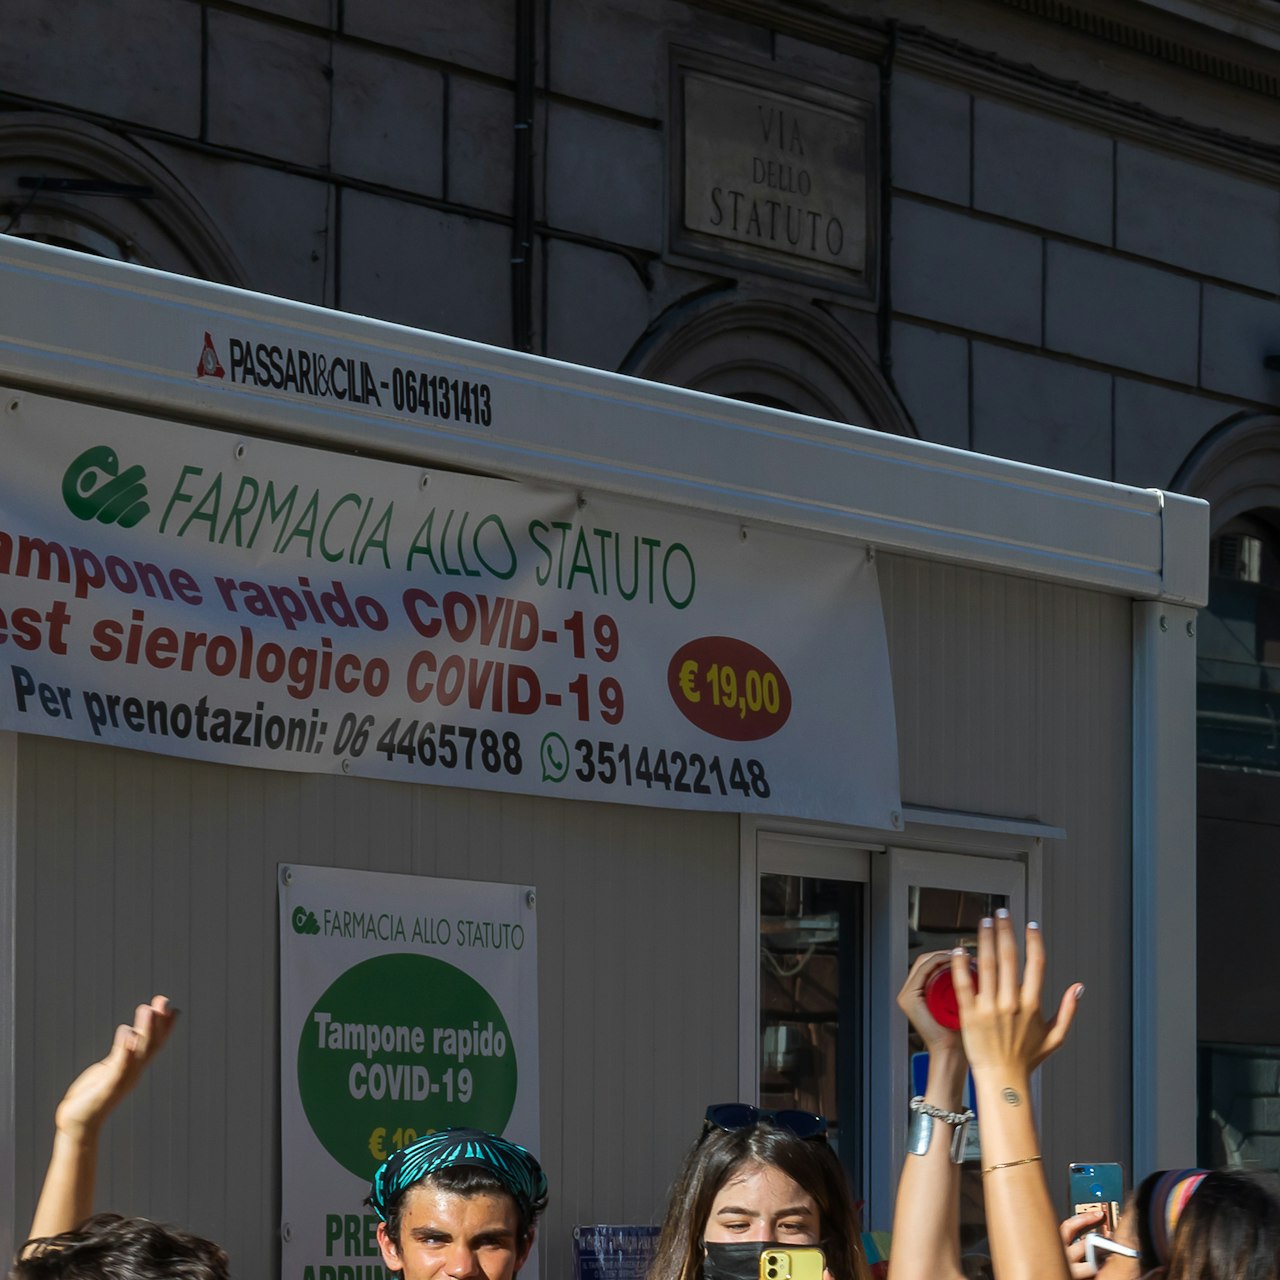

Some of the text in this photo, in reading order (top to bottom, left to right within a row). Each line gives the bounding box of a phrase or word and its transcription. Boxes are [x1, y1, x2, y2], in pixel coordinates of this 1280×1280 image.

[757, 105, 804, 156] VIA
[753, 157, 811, 197] DELLO
[709, 187, 844, 256] STATUTO
[392, 367, 492, 427] 064131413
[159, 465, 696, 609] FARMACIA ALLO STATUTO
[214, 576, 389, 632] rapido
[402, 587, 619, 663] COVID-19
[90, 609, 391, 700] sierologico
[407, 650, 625, 726] COVID-19
[679, 660, 700, 703] €
[706, 664, 780, 720] 19,00
[11, 665, 770, 799] Per prenotazioni: 06 4465788 3514422148
[324, 909, 524, 950] FARMACIA ALLO STATUTO
[314, 1012, 506, 1063] Tampone rapido
[349, 1062, 473, 1103] COVID-19
